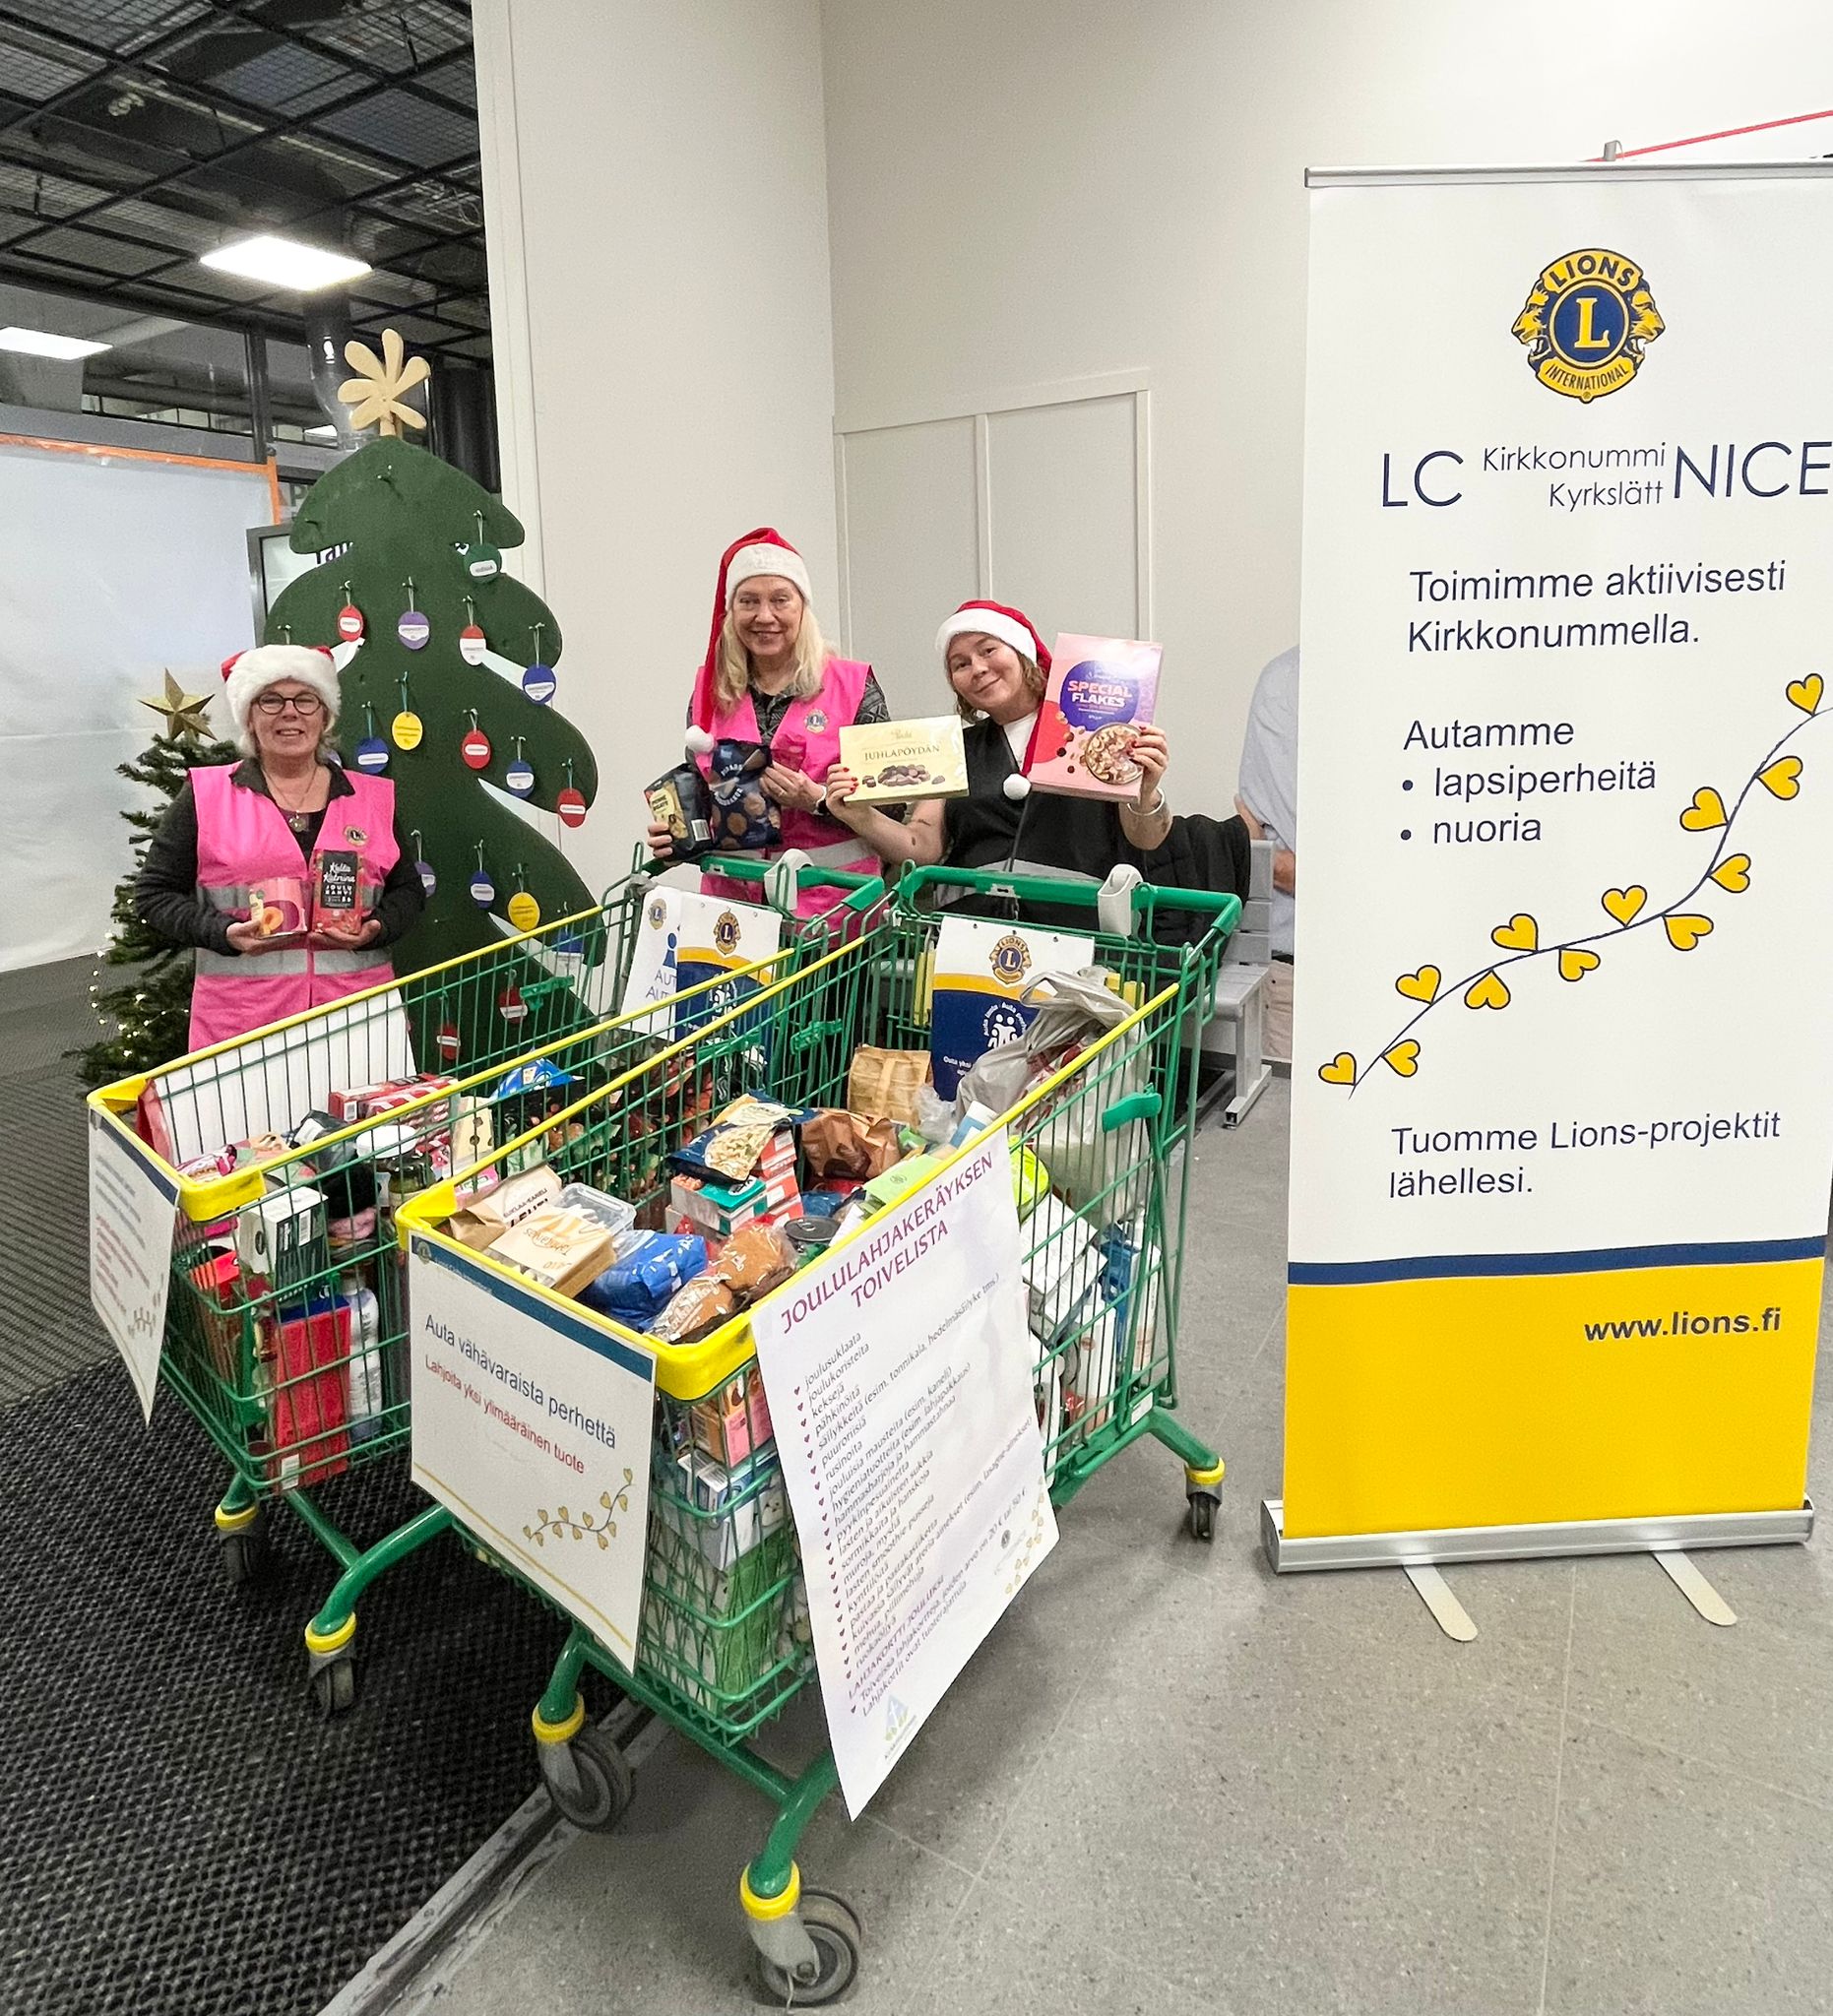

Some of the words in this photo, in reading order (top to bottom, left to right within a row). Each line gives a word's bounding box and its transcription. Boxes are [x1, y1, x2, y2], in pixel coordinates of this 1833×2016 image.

[1549, 255, 1635, 286] LIONS
[1575, 298, 1610, 348] L
[1545, 363, 1629, 390] INTERNATIONAL
[1382, 451, 1464, 507] LC
[1483, 442, 1666, 472] Kirkkonummi
[1674, 441, 1833, 499] NICE
[1549, 481, 1663, 512] Kyrkslätt
[1410, 570, 1593, 602] Toimimme
[1606, 560, 1786, 597] aktiivisesti
[1409, 613, 1700, 653] Kirkkonummella.
[1068, 680, 1132, 698] SPECIAL
[1072, 693, 1125, 708] FLAKES
[864, 743, 940, 761] JUHLAPÖYDÄN
[1404, 719, 1575, 752] Autamme
[1434, 760, 1657, 802] lapsiperheitä
[1432, 813, 1542, 845] nuoria
[1392, 1123, 1539, 1156] Tuomme
[1550, 1111, 1782, 1153] Lions-projektit
[1389, 1165, 1534, 1199] lähellesi.
[781, 1151, 992, 1334] JOULULAHJAKERÄYKSEN
[850, 1219, 948, 1307] TOIVELISTA
[1585, 1305, 1782, 1343] www.lions.fi
[425, 1314, 455, 1347] Auta
[459, 1337, 543, 1406] vähävaraista
[548, 1396, 616, 1449] perhettä
[425, 1354, 462, 1390] Lahjoita
[463, 1382, 482, 1408] yksi
[483, 1396, 551, 1453] ylimääräinen
[553, 1444, 585, 1475] tuote
